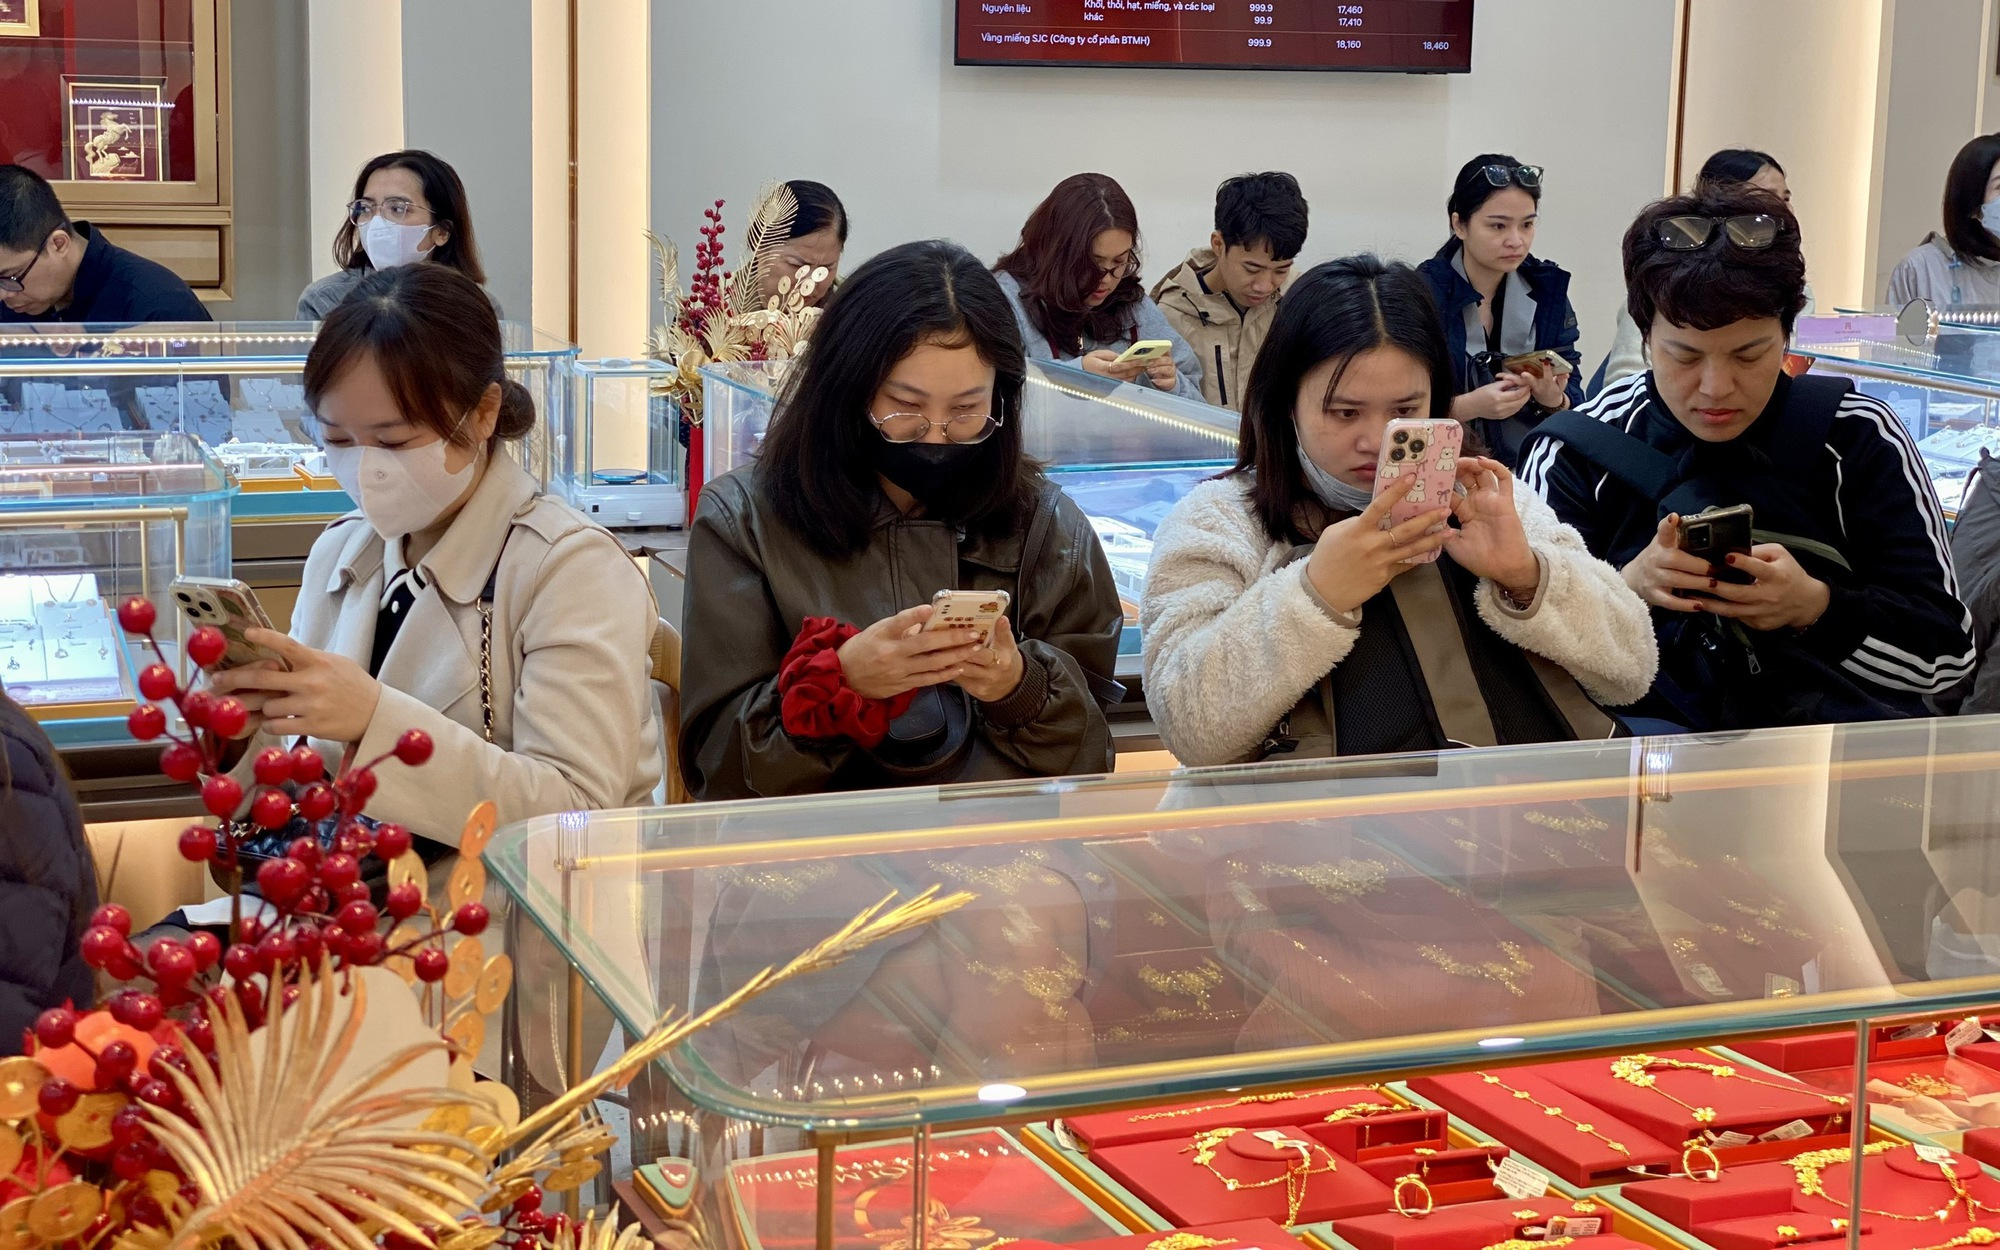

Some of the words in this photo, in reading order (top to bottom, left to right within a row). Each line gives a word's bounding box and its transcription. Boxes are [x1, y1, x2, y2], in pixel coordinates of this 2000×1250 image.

[981, 3, 1015, 14] Nguyên
[1016, 4, 1031, 14] liệu
[1126, 1, 1142, 12] hạt,
[1173, 1, 1183, 11] và
[1185, 2, 1199, 11] các
[1201, 2, 1215, 13] loại
[1249, 3, 1273, 13] 999.9
[1337, 5, 1363, 15] 17,460
[1083, 12, 1104, 21] khác
[1254, 16, 1273, 25] 99.9
[1338, 17, 1363, 27] 17,410
[981, 32, 1002, 43] Vàng
[1004, 32, 1030, 44] miếng
[1032, 34, 1048, 43] SJC
[1050, 34, 1075, 46] (Công
[1076, 35, 1085, 46] ty
[1121, 36, 1150, 46] BTMH)
[1247, 38, 1272, 48] 999.9
[1336, 40, 1361, 50] 18,160
[1423, 41, 1449, 51] 18,460
